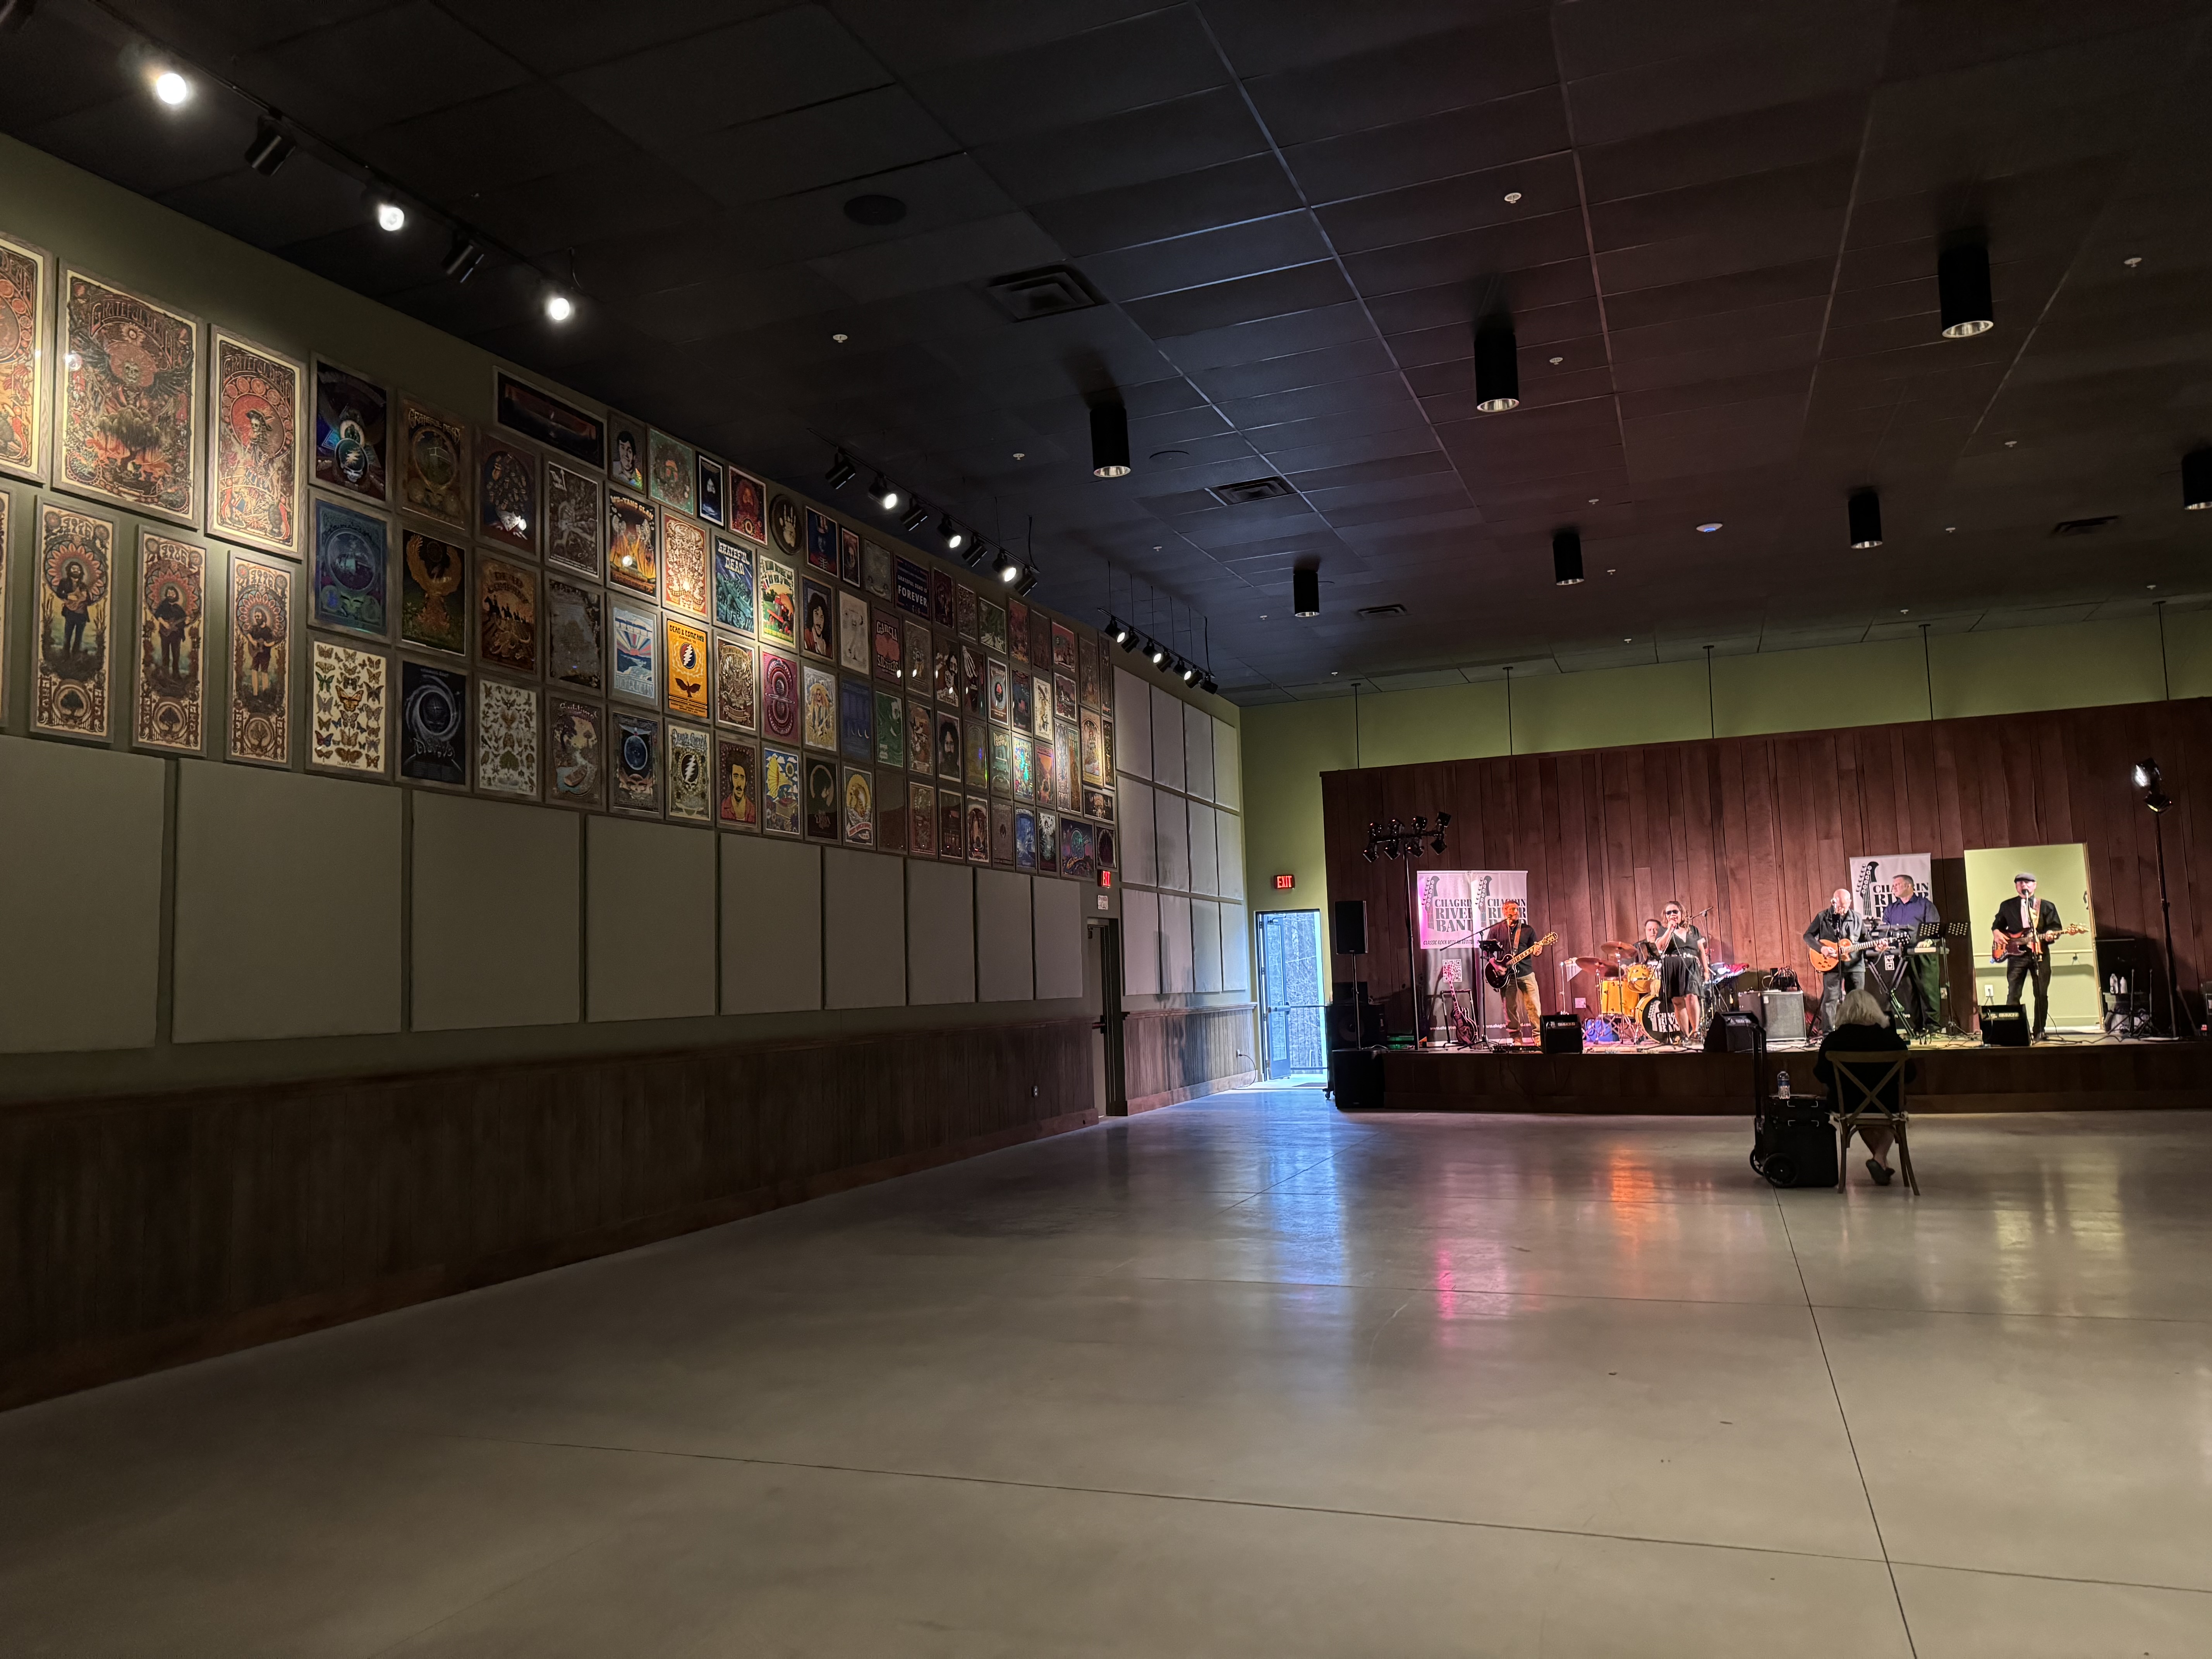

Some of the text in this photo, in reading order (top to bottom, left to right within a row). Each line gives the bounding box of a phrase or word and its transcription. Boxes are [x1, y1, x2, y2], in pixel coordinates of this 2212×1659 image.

[639, 505, 654, 520] CLAN
[718, 540, 750, 565] GRATEFUL
[725, 556, 745, 575] DEAD
[898, 585, 927, 607] FOREVER
[670, 625, 681, 634] DEAD
[685, 630, 704, 642] COMPANY
[877, 621, 898, 641] GARCIA
[1277, 876, 1292, 888] EXIT
[1873, 883, 1929, 893] CHIN
[1488, 907, 1526, 918] RIR
[1659, 1024, 1680, 1032] BAN
